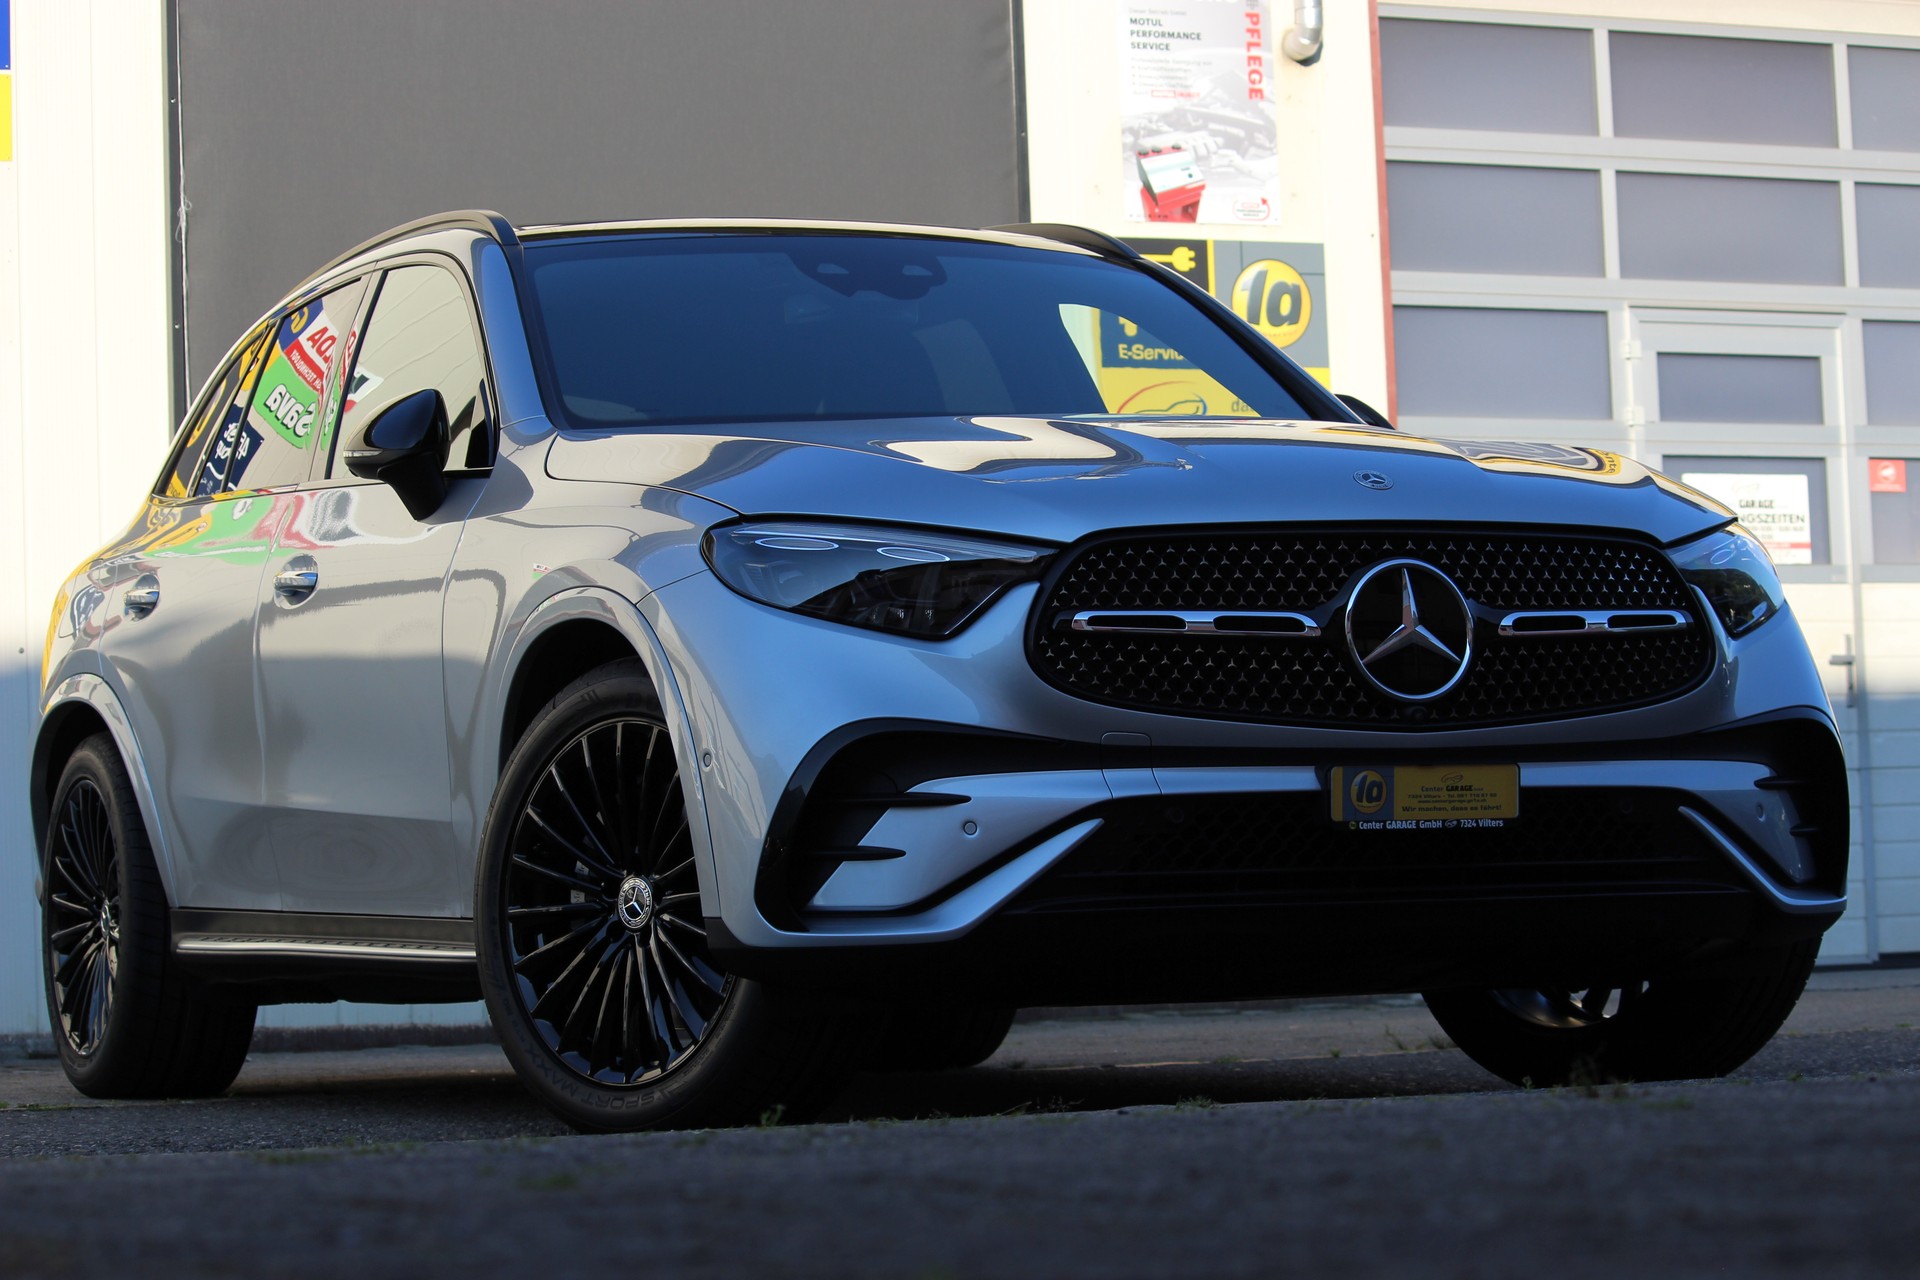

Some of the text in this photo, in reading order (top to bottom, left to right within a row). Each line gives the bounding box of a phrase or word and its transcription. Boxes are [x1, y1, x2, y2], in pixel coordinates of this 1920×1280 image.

[1129, 17, 1163, 28] MOTUL
[1130, 29, 1202, 41] PERFORMANCE
[1131, 41, 1171, 51] SERVICE
[1245, 12, 1264, 101] PFLEGE
[1739, 499, 1775, 509] GARAGE
[1738, 513, 1805, 524] NGSZEITEN
[1359, 821, 1384, 830] Center
[1386, 820, 1417, 829] GARAGE
[1419, 820, 1442, 829] GmbH
[1460, 819, 1477, 828] 7324
[1478, 818, 1504, 827] Vilters
[524, 1044, 579, 1096] MAXX
[581, 1091, 656, 1111] SPORT
